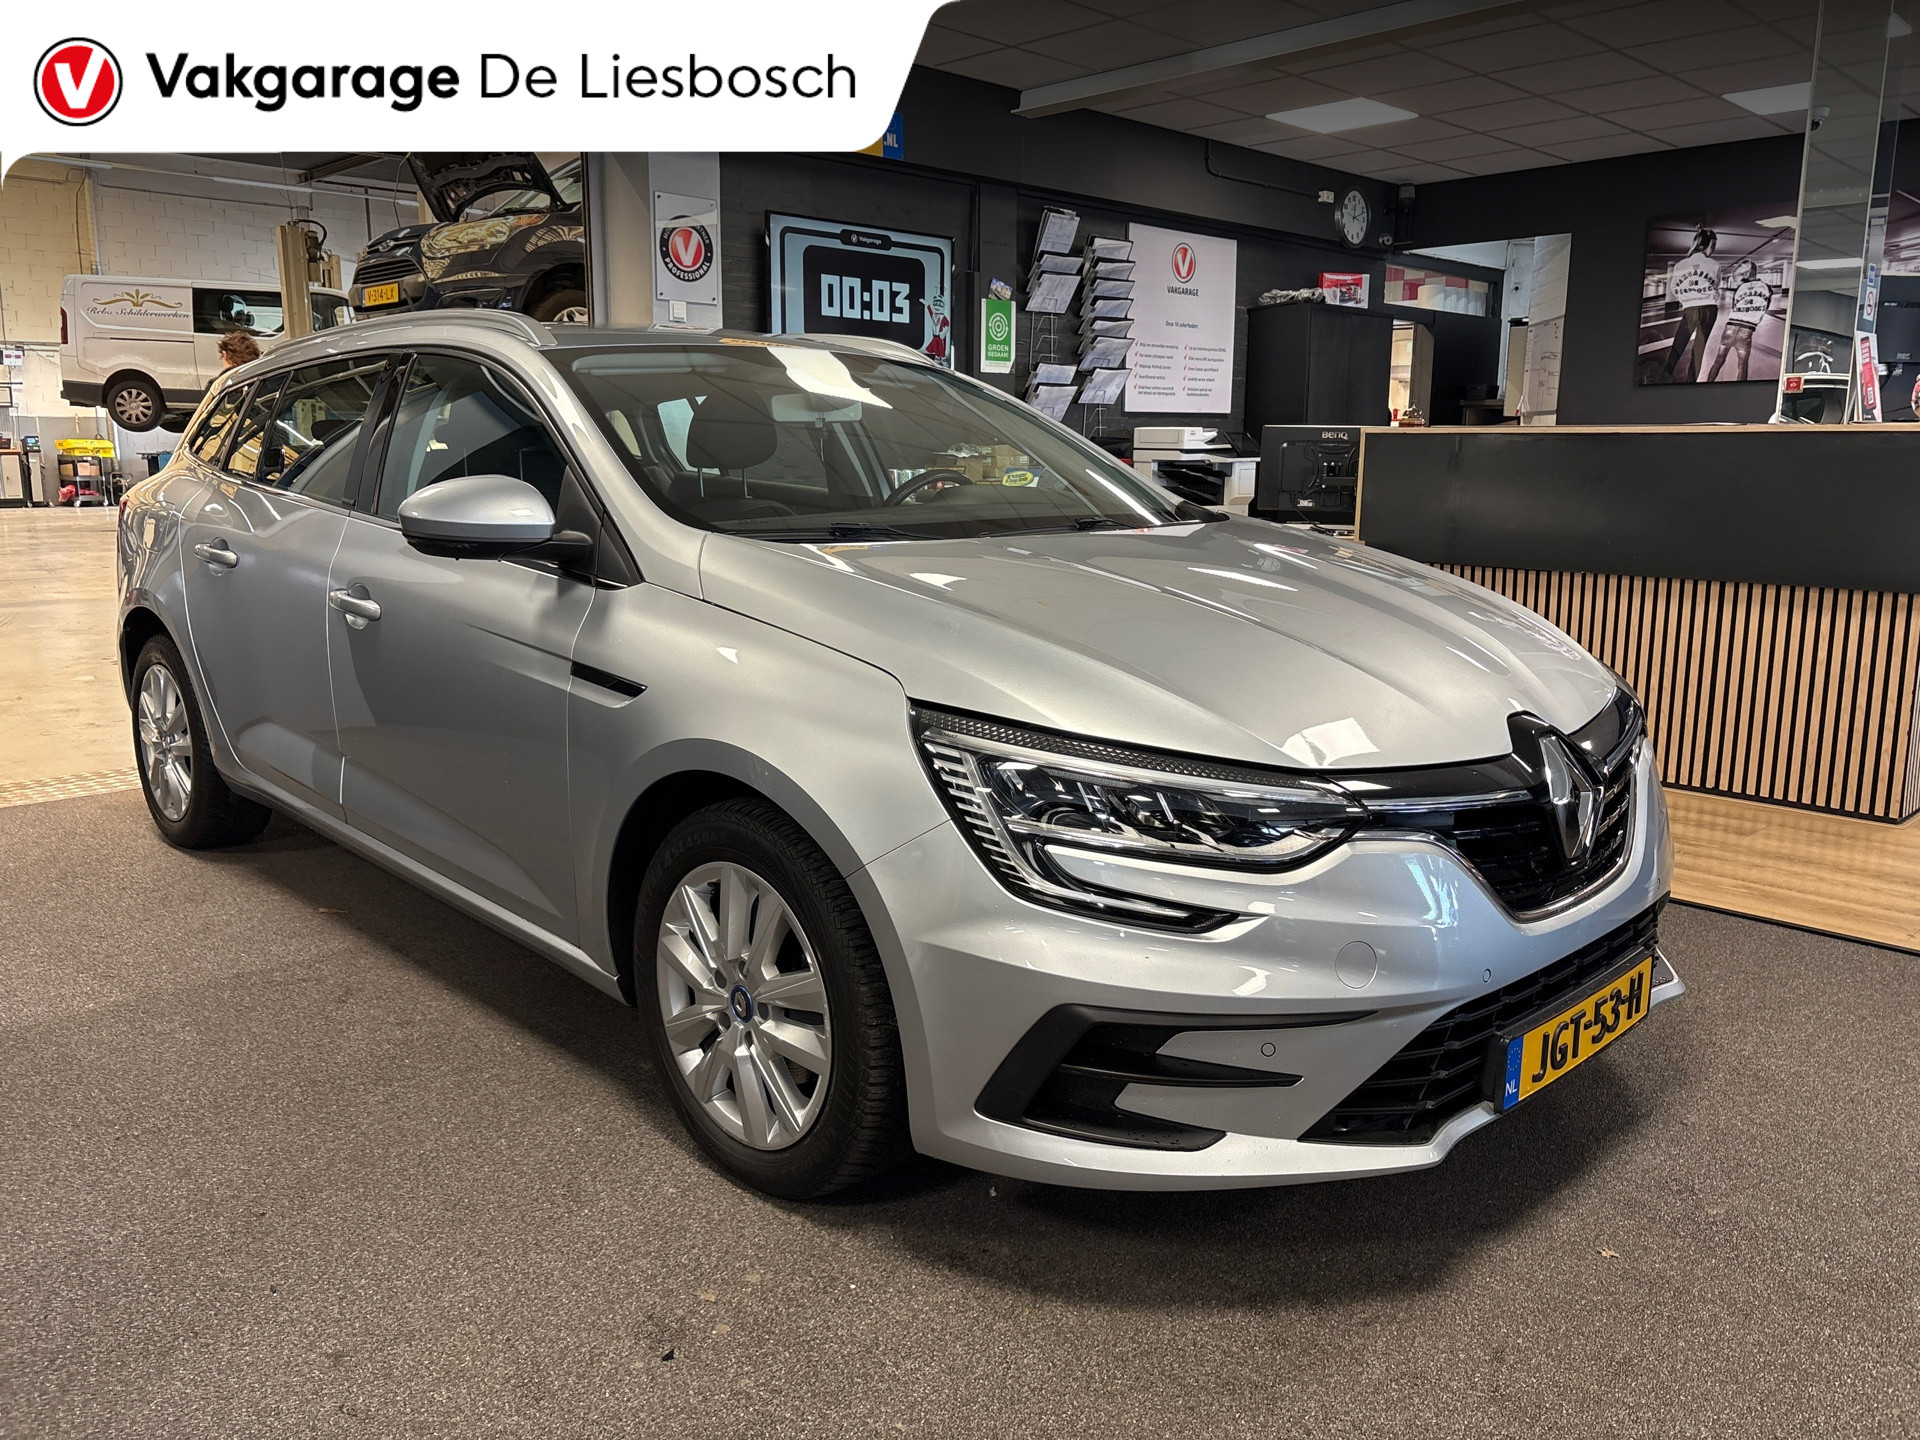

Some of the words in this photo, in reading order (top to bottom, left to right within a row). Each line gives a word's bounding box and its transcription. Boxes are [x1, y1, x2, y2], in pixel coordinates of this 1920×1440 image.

[664, 257, 710, 280] PROFESSIONAL
[367, 286, 395, 303] V-314-LX
[820, 273, 910, 324] 00:03
[1166, 286, 1199, 297] VAKGARAGE
[116, 308, 190, 319] Schilderwerken
[988, 343, 1009, 352] GROEN
[1531, 970, 1645, 1083] JGT-53-H
[1505, 1079, 1518, 1097] NL
